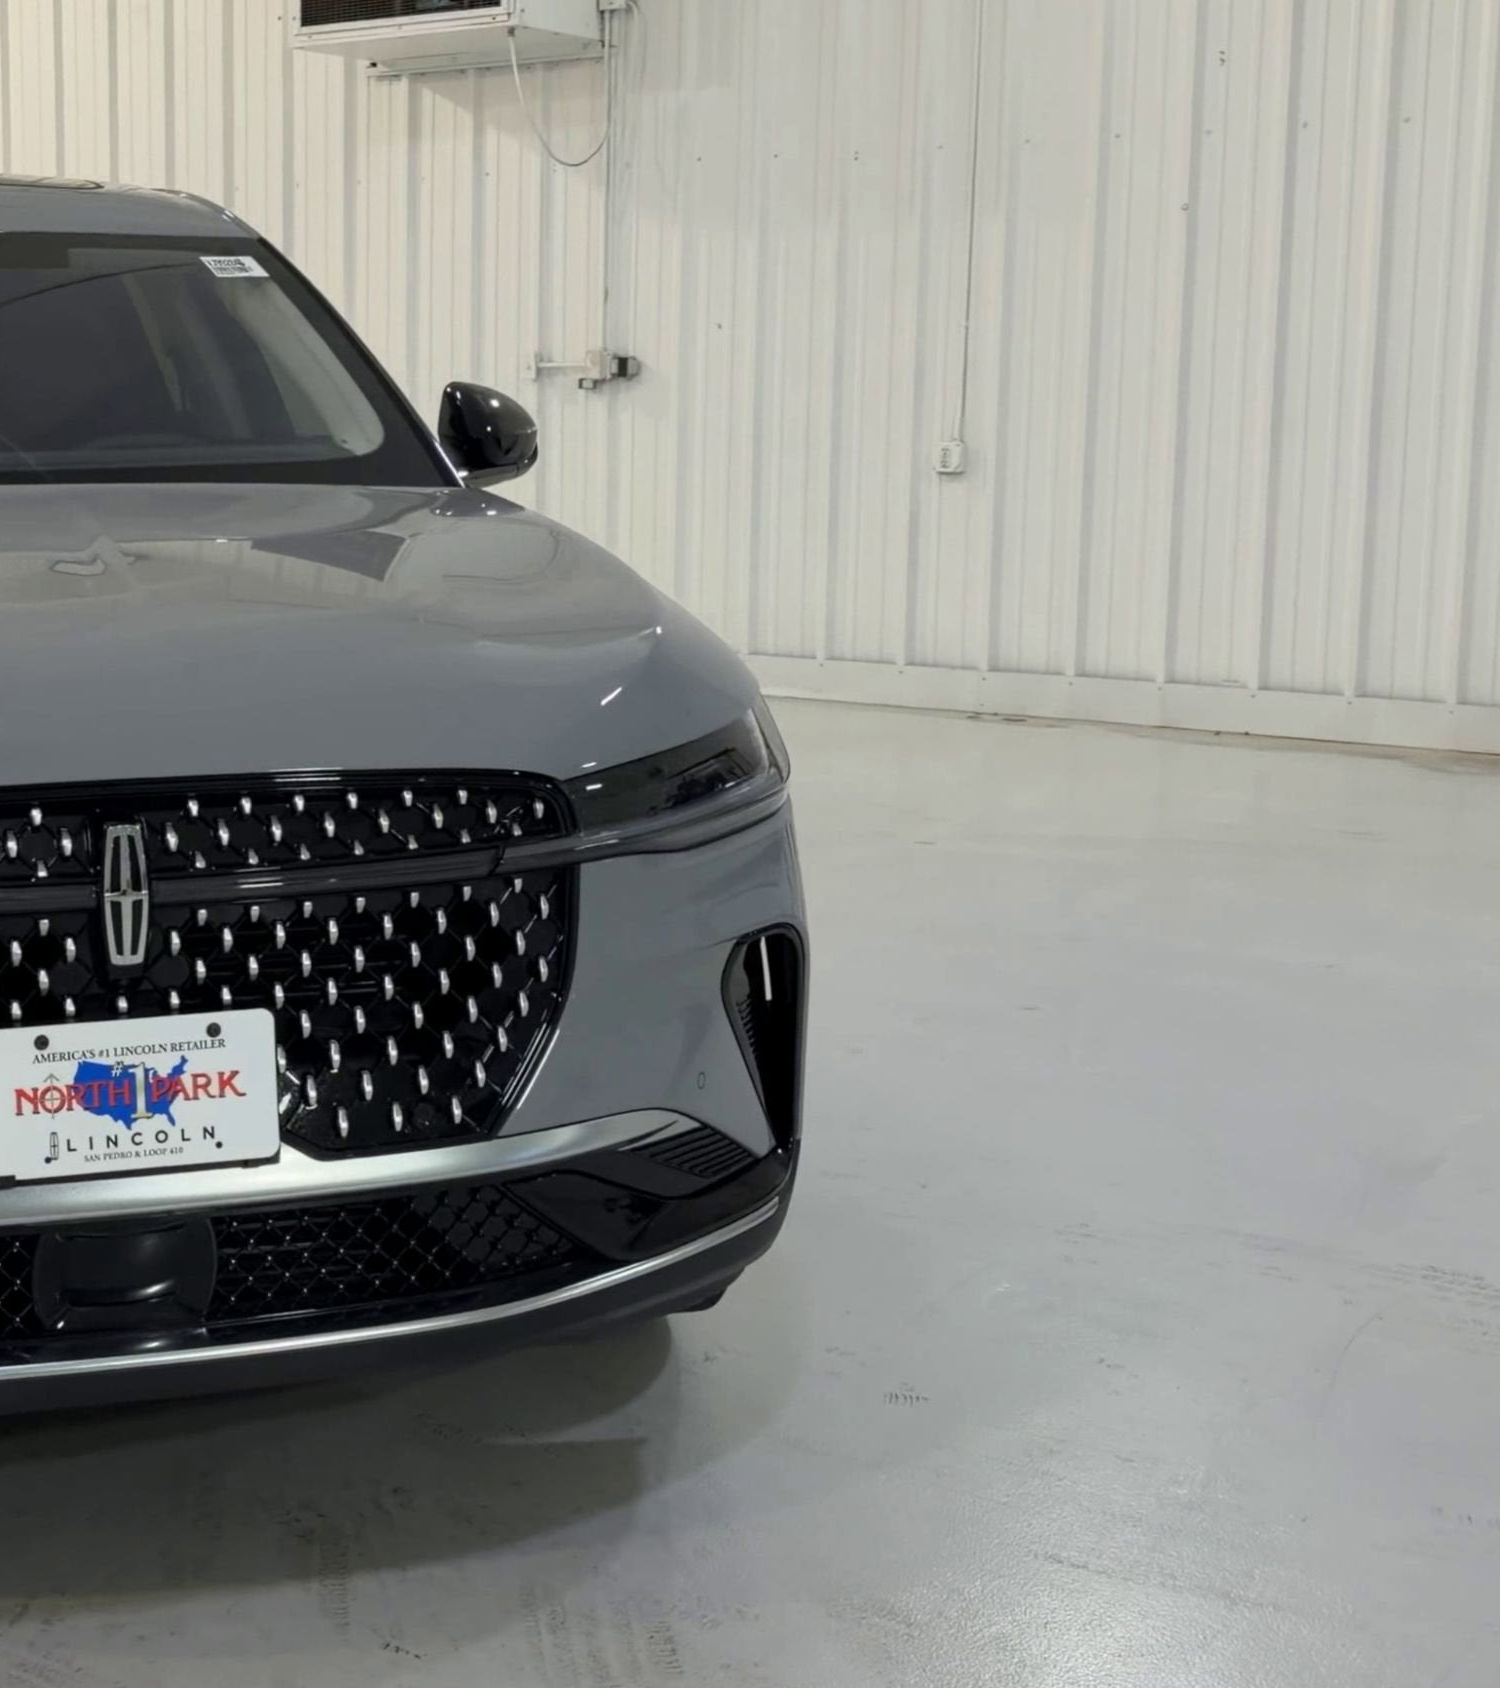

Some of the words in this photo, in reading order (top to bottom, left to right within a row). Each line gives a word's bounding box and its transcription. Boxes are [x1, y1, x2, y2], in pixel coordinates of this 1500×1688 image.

[33, 1048, 96, 1064] AMERICA'S
[98, 1048, 110, 1058] #1
[113, 1043, 168, 1057] LINCOLN
[170, 1038, 226, 1053] RETAILER
[14, 1078, 132, 1116] NORTH
[151, 1069, 247, 1103] PARK
[66, 1125, 216, 1152] LINCOLN
[84, 1154, 101, 1162] SAN
[103, 1151, 132, 1160] PEDRO
[134, 1150, 142, 1158] &
[144, 1148, 168, 1157] LOOP
